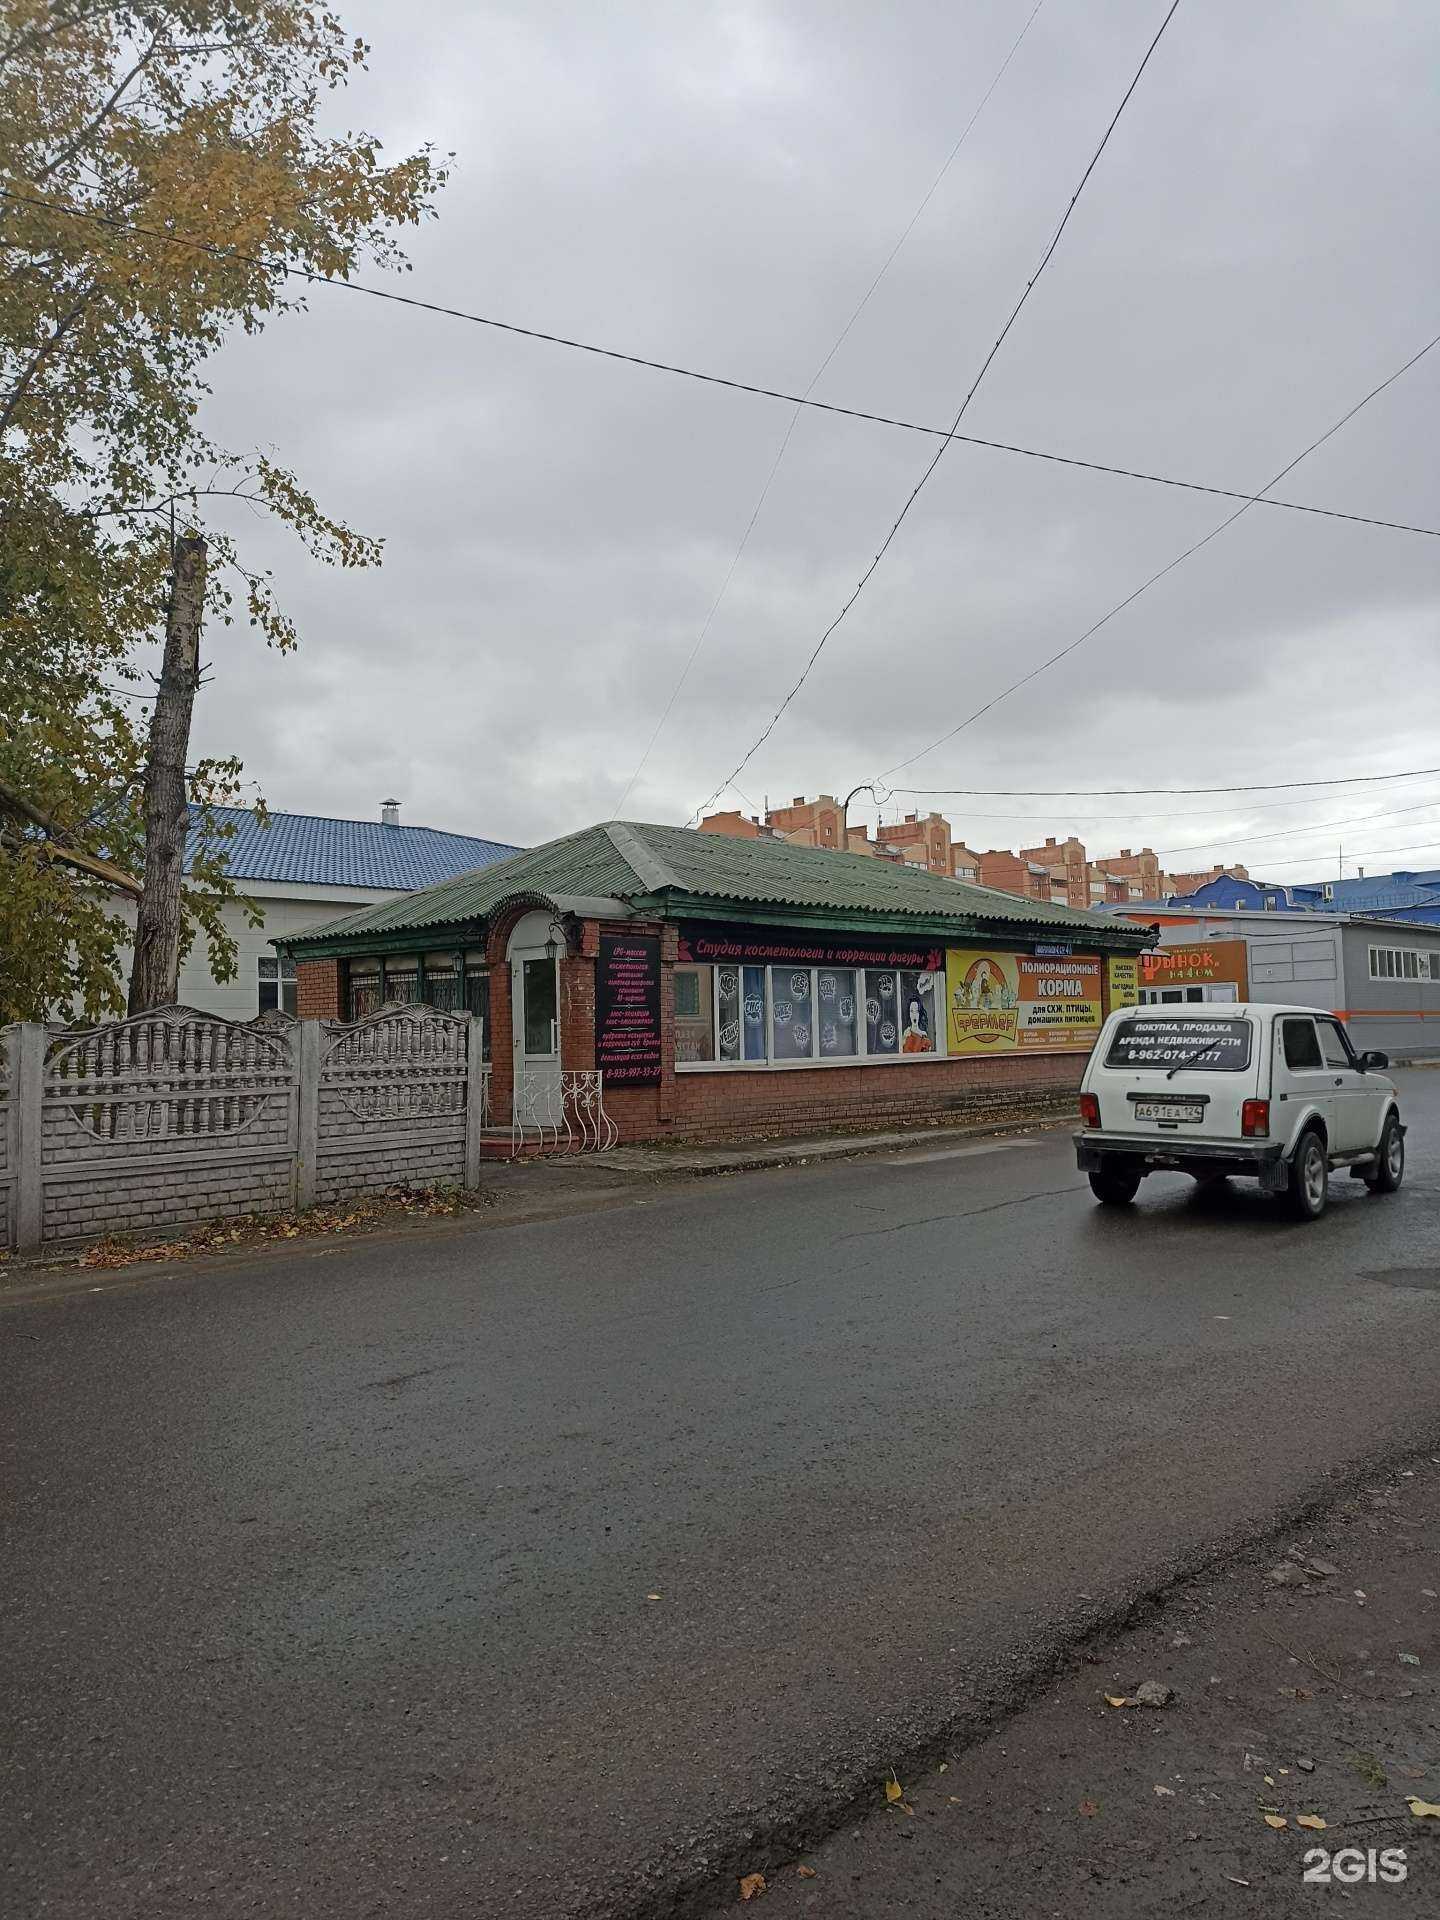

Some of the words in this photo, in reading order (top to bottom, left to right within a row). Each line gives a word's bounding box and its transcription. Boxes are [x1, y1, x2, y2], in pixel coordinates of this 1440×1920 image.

[696, 941, 742, 956] Студия
[745, 947, 825, 960] косметологии
[827, 950, 834, 960] и
[836, 951, 887, 964] коррекции
[888, 952, 924, 966] фигуры
[1021, 962, 1098, 976] ПОЛНОРАЦИОННЫЕ
[1038, 979, 1083, 997] КОРМА
[1032, 1005, 1046, 1015] для
[958, 1013, 1015, 1032] ФЕРМЕР
[1028, 1016, 1064, 1025] домашних
[1065, 1015, 1096, 1024] питомцев
[1135, 1023, 1180, 1033] ПОКУПКА,
[1182, 1023, 1232, 1033] ПРОДАЖА
[1118, 1036, 1155, 1045] АРЕНДА
[1184, 1106, 1200, 1116] 124
